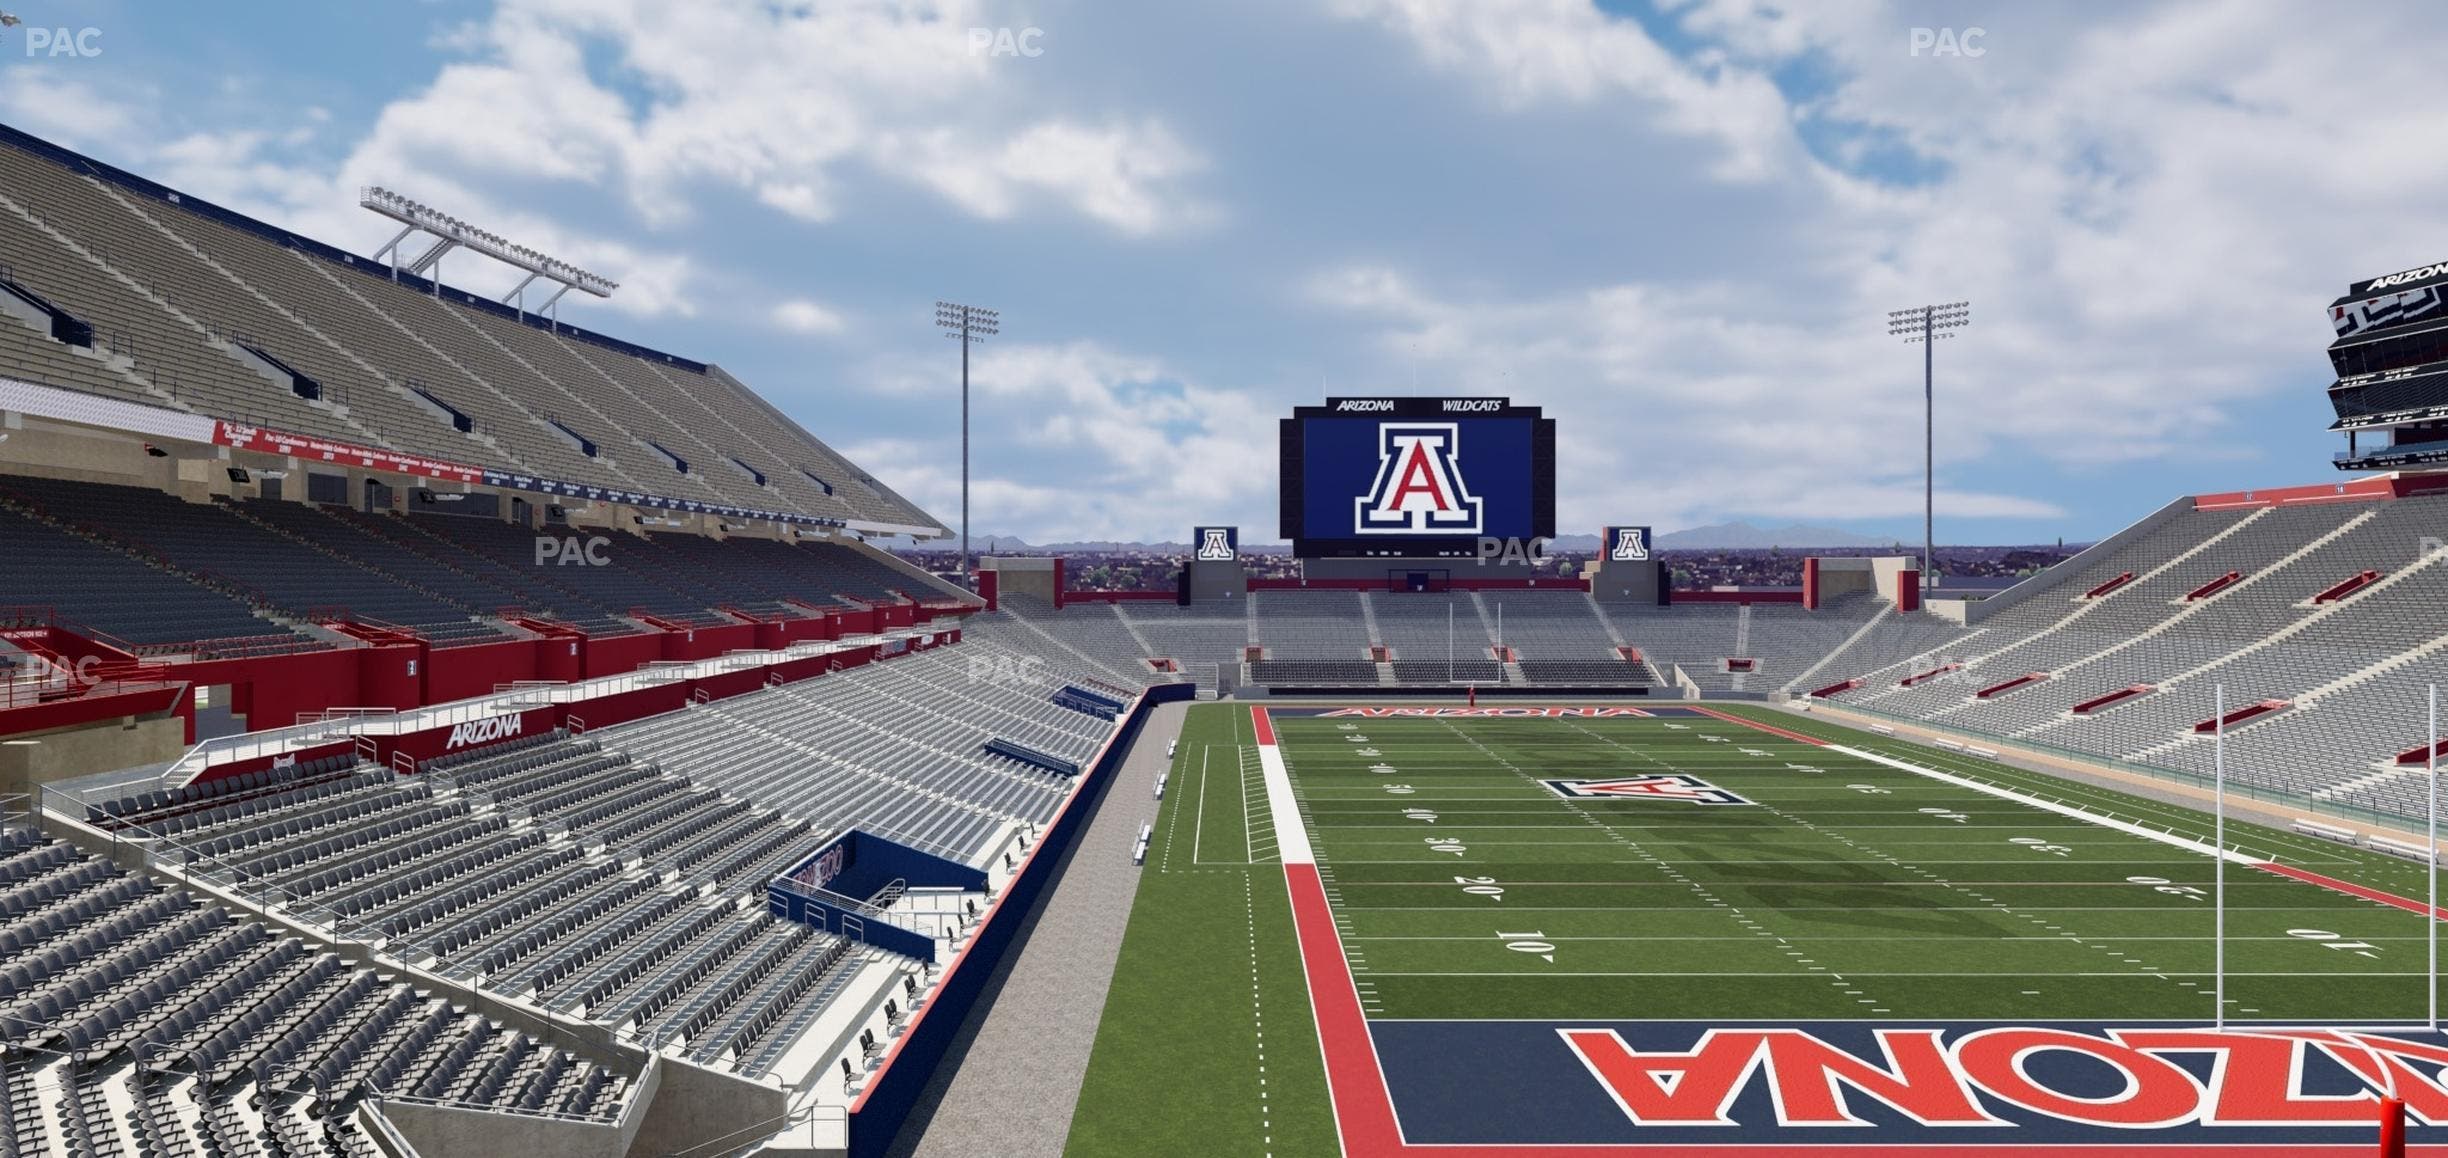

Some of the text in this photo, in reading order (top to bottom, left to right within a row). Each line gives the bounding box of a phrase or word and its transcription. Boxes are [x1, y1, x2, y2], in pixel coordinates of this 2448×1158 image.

[1336, 399, 1502, 412] ARIZONA WILDCATS
[1355, 422, 1483, 534] A
[1198, 529, 1235, 561] A
[1612, 529, 1650, 561] A
[1315, 707, 1657, 718] ARIZONA
[446, 713, 522, 750] ARIZONA
[1424, 837, 1467, 852] 30
[1454, 876, 1504, 894] 20
[2126, 876, 2208, 895] 20
[1496, 930, 1556, 953] 10
[2286, 929, 2384, 951] 10
